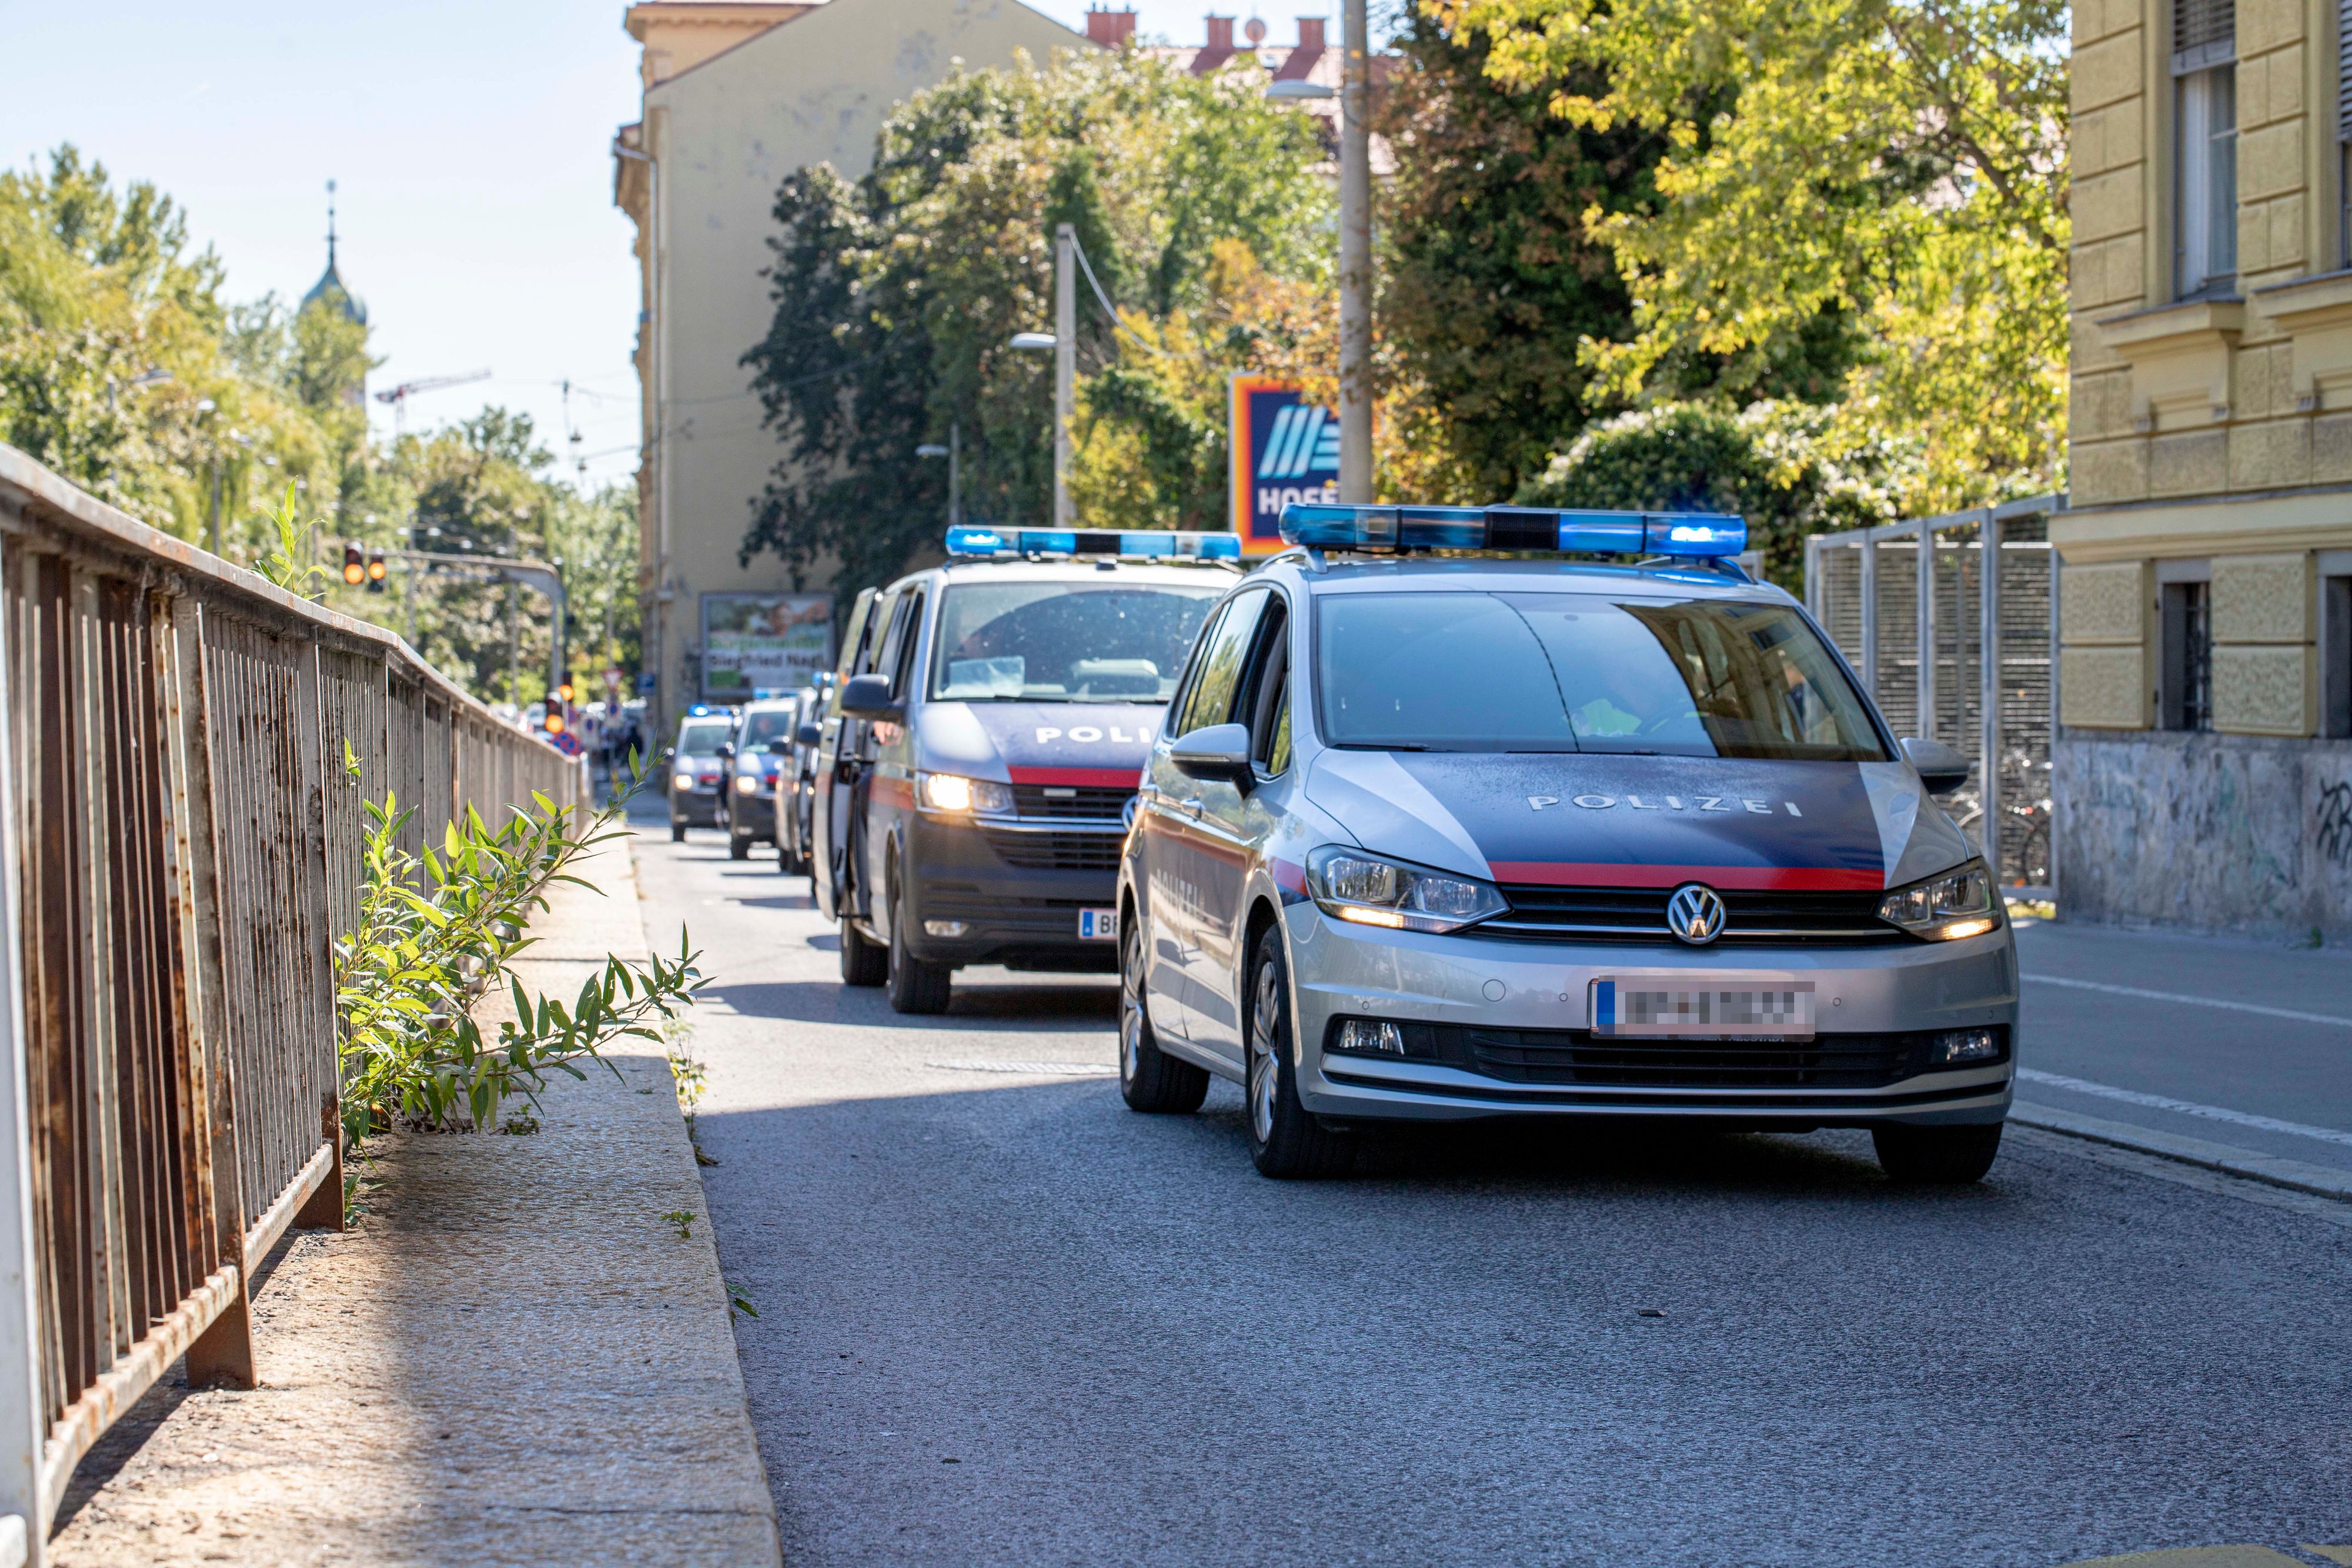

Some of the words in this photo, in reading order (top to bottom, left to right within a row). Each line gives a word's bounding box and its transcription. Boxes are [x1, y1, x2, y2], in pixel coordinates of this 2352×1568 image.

[1258, 487, 1339, 514] HOFE
[1035, 726, 1151, 744] POLI
[1527, 795, 1803, 817] POLIZEI
[1669, 885, 1726, 943] VW
